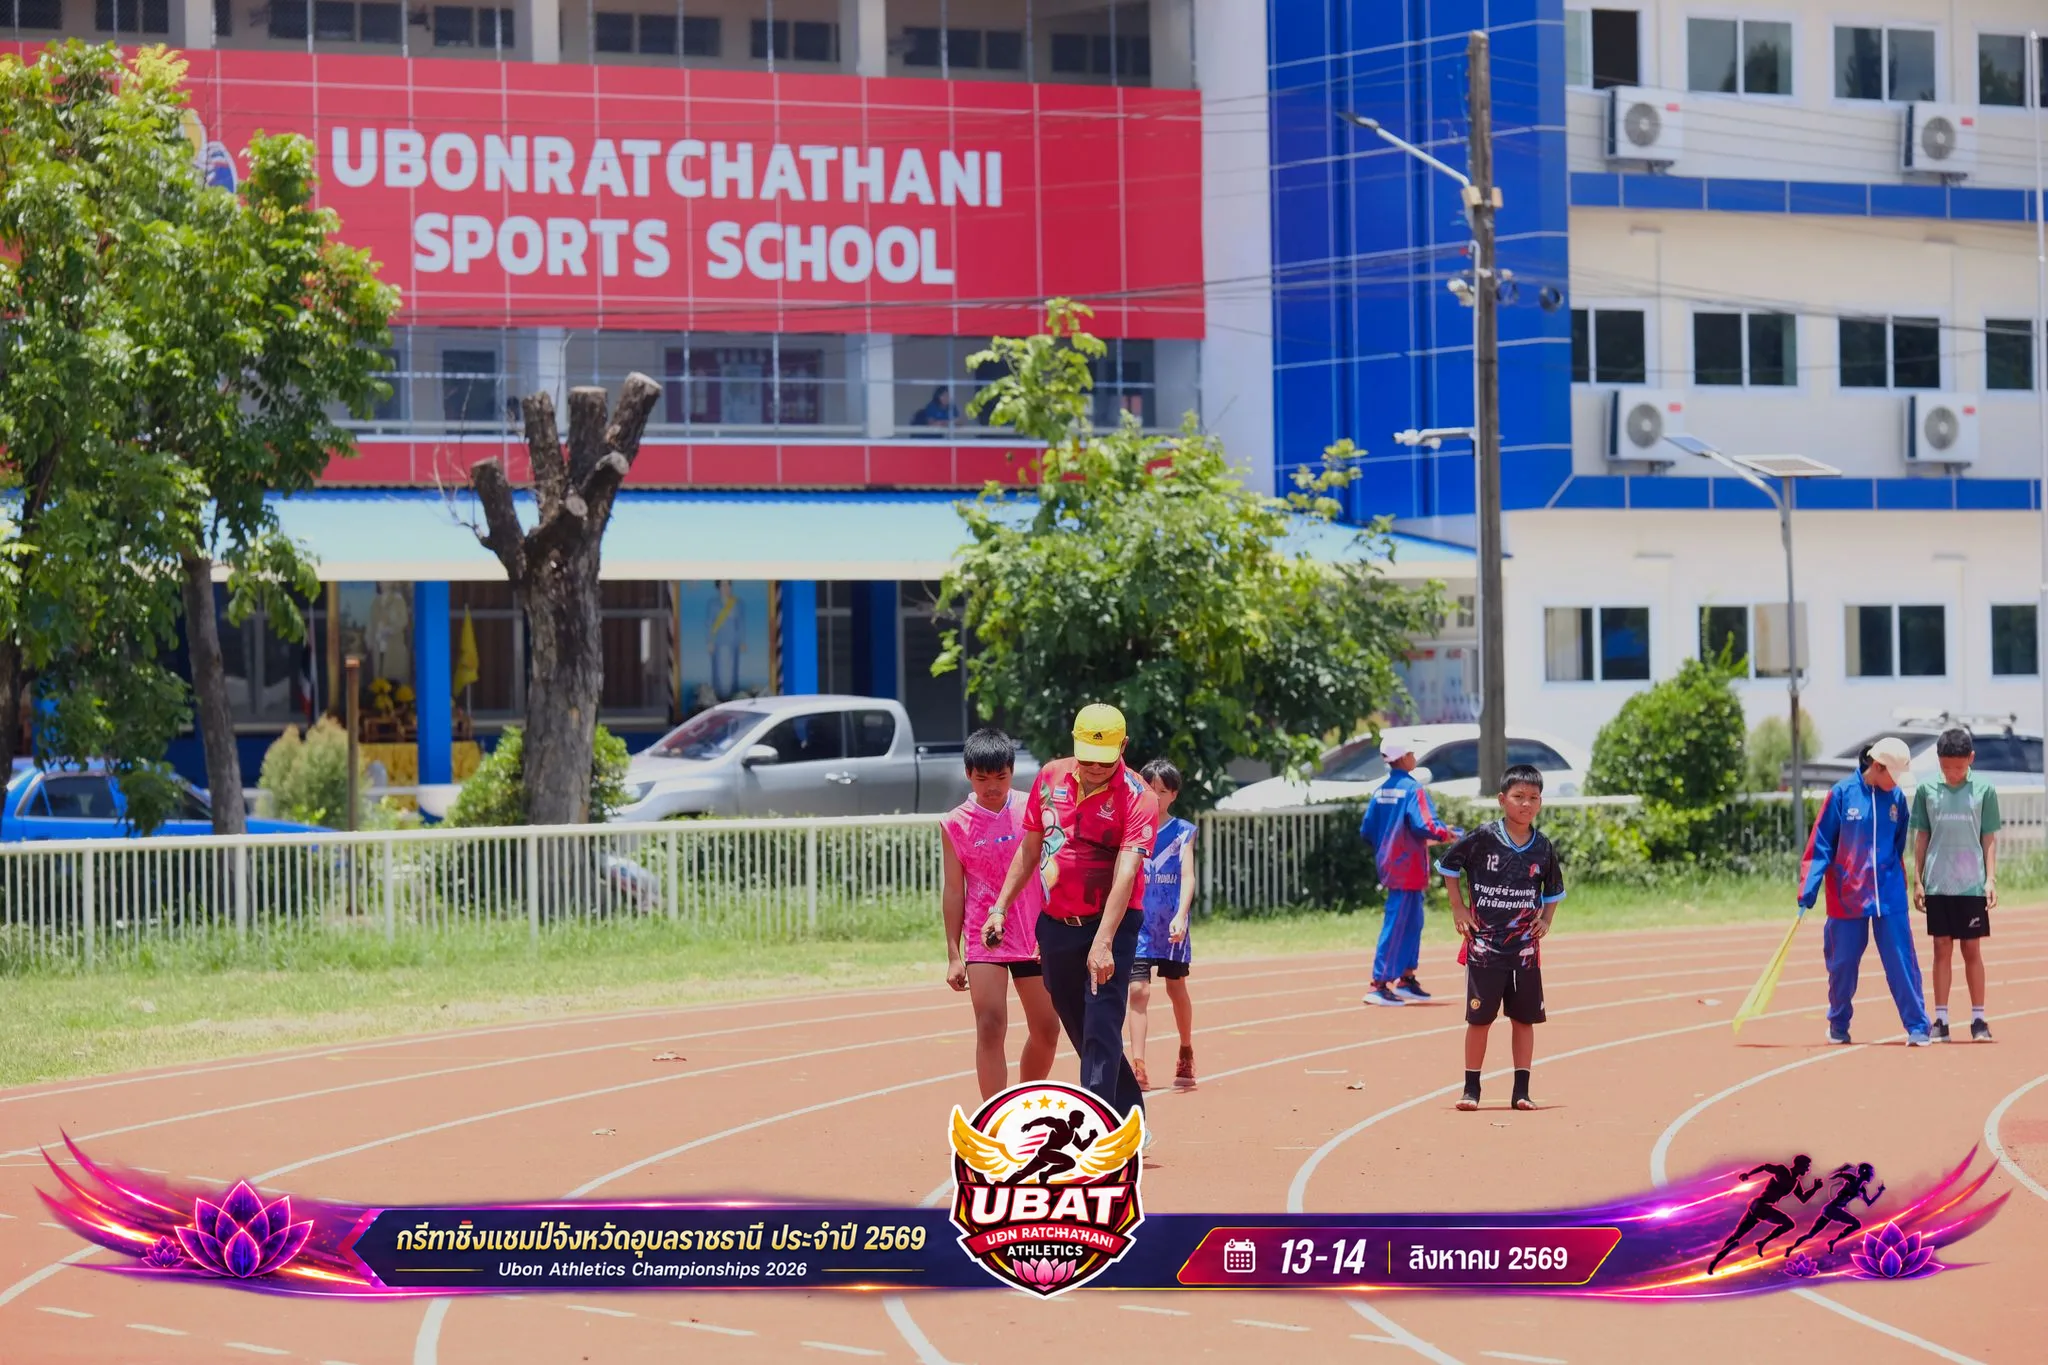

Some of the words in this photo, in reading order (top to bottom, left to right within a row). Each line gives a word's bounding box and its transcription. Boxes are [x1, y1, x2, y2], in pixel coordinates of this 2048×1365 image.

[331, 127, 1003, 209] UBONRATCHATHANI
[412, 213, 670, 278] SPORTS
[705, 223, 956, 285] SCHOOL
[1486, 854, 1500, 872] 12
